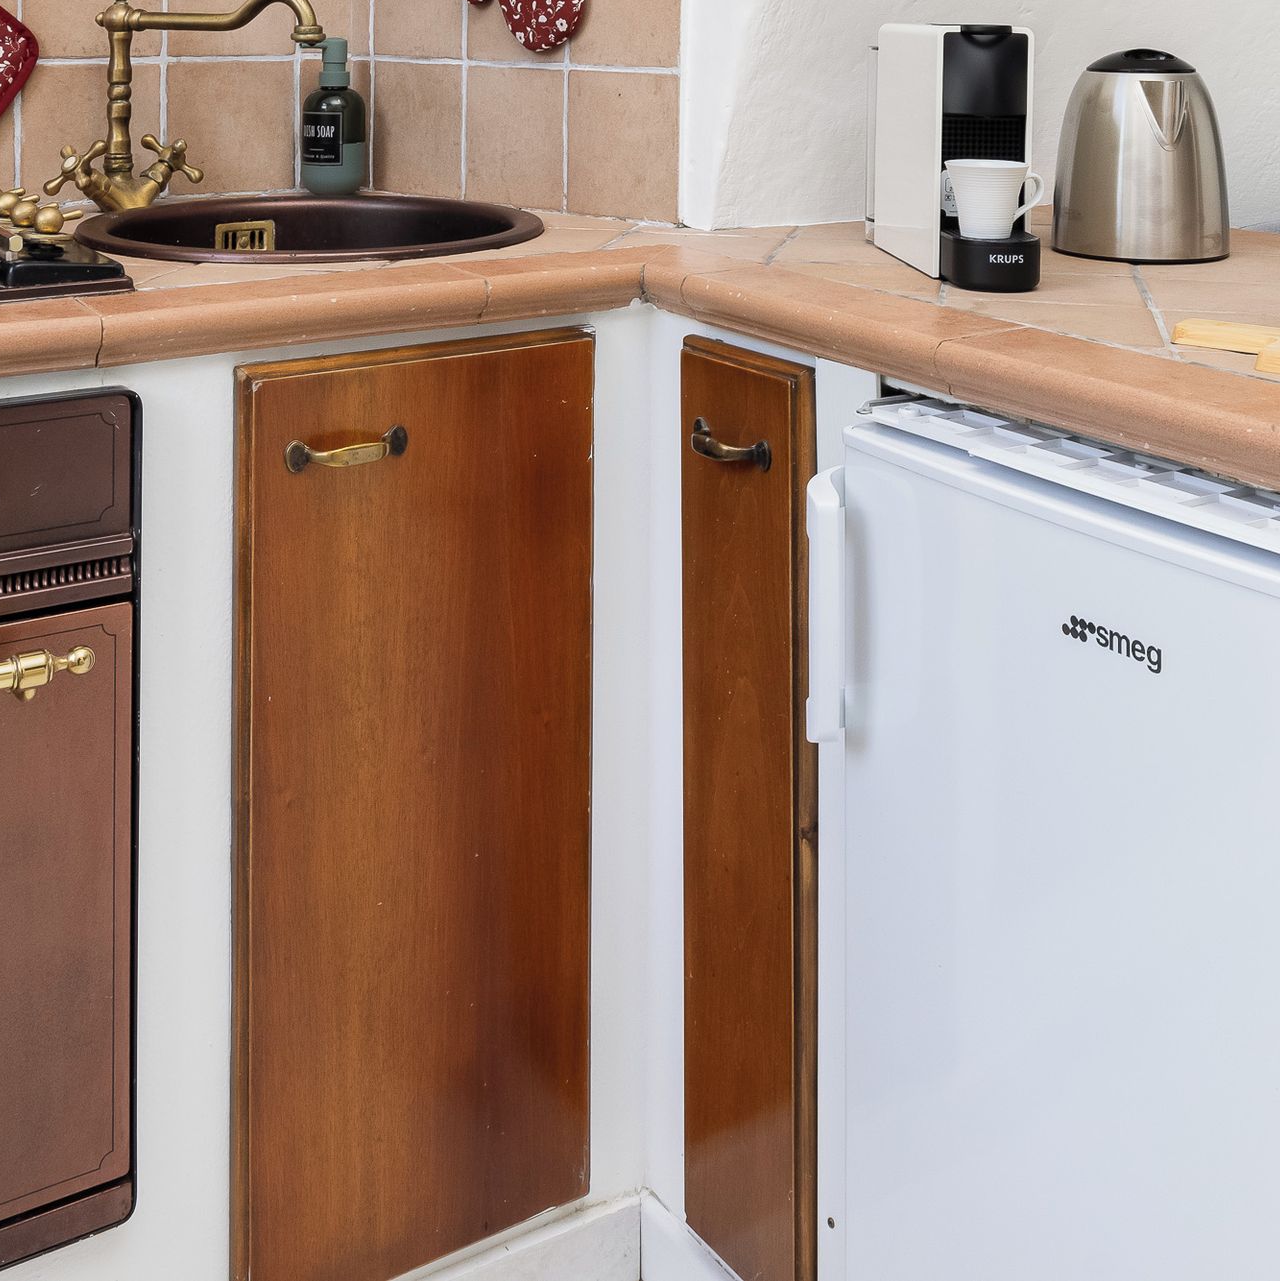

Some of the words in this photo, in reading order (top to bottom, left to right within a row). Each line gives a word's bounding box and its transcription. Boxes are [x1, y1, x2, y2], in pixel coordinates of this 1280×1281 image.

[317, 125, 334, 137] SOAP
[989, 254, 1024, 263] KRUPS
[1096, 626, 1162, 674] smeg
